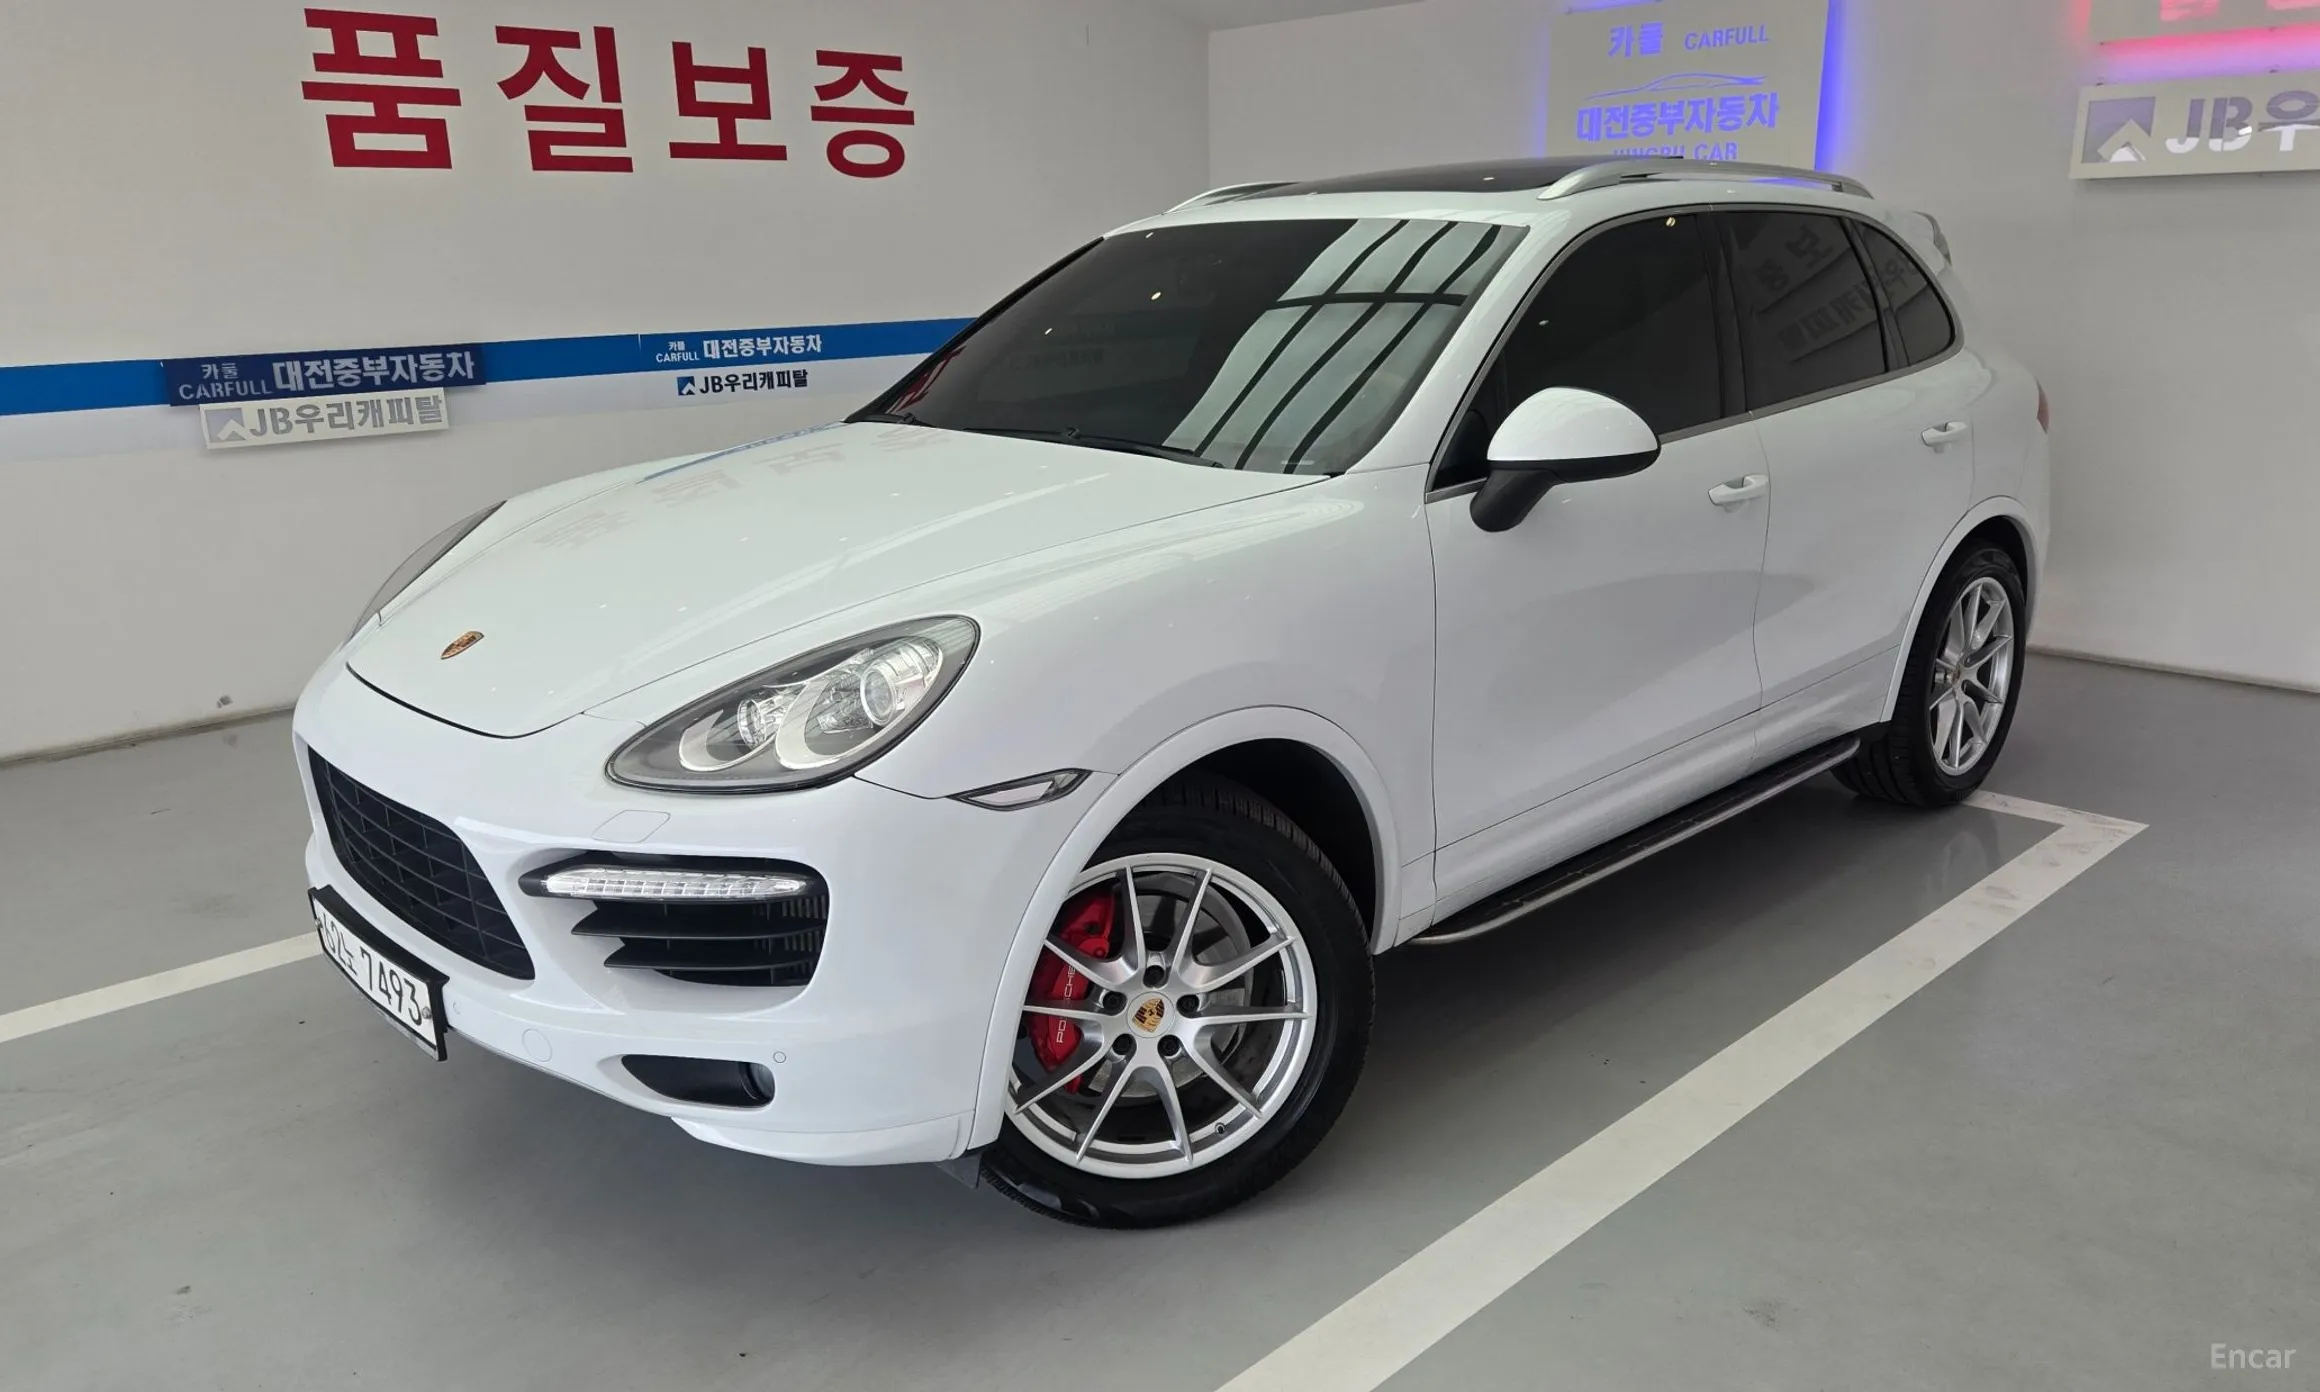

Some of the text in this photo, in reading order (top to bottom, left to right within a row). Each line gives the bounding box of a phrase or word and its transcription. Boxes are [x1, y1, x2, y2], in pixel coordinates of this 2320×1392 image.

[1684, 24, 1770, 51] CARFULL
[301, 8, 915, 179] 품질보증
[1576, 92, 1780, 142] 대전중부자동차
[1693, 142, 1738, 161] CAR
[655, 334, 822, 364] CARFULL 대전중부자동차
[178, 351, 475, 400] CARFULL 대전중부자동차
[699, 369, 808, 394] JB우리캐피탈
[249, 394, 445, 437] JB우리캐피탈
[360, 945, 422, 1027] 7493
[1056, 965, 1076, 1044] POCHE
